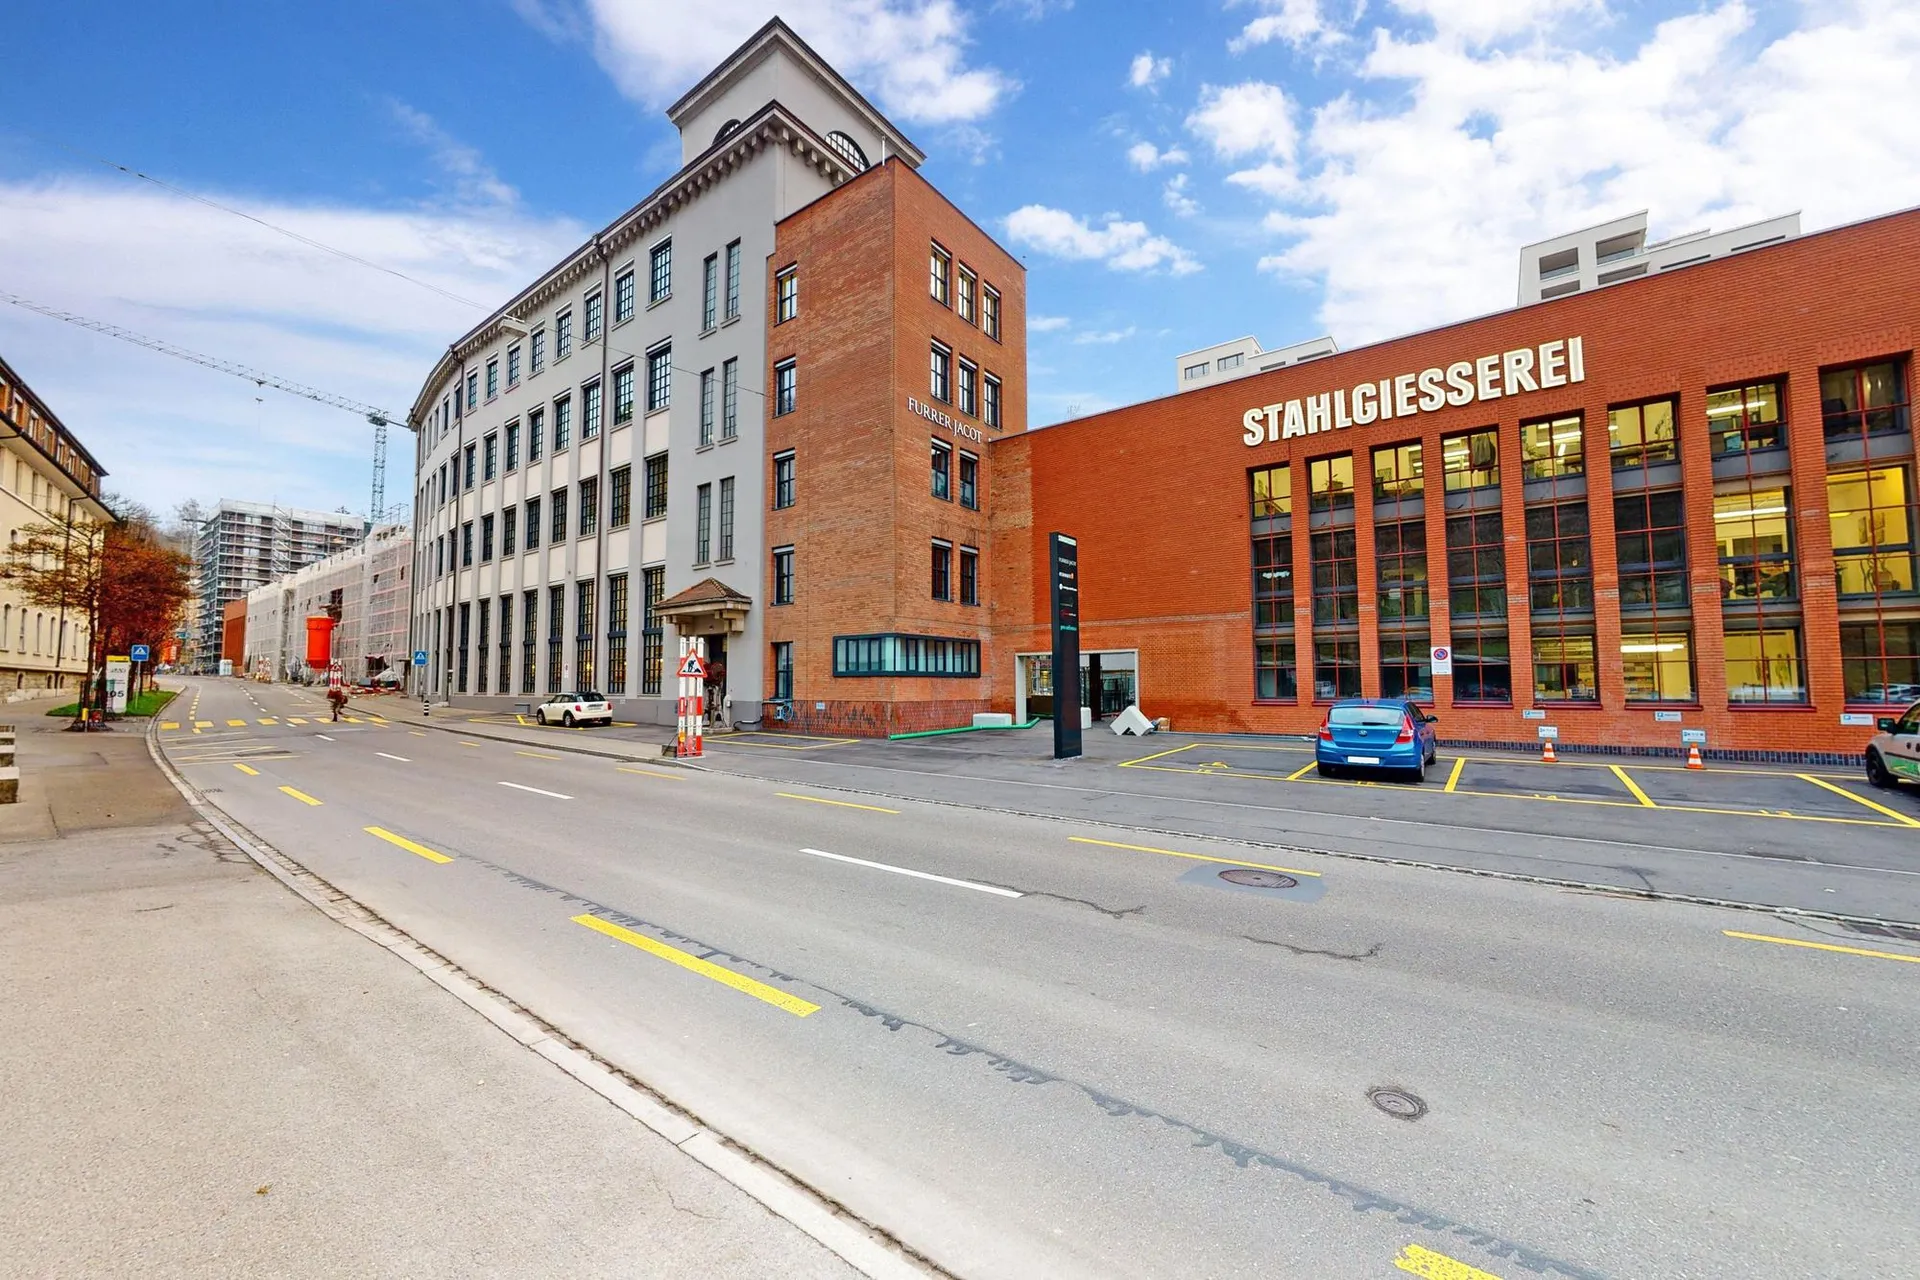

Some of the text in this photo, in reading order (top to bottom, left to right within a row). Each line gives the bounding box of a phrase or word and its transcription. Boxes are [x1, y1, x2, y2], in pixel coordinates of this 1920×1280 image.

[908, 396, 983, 444] FURRER JACOT
[1243, 335, 1585, 447] STAHLGIESSEREI
